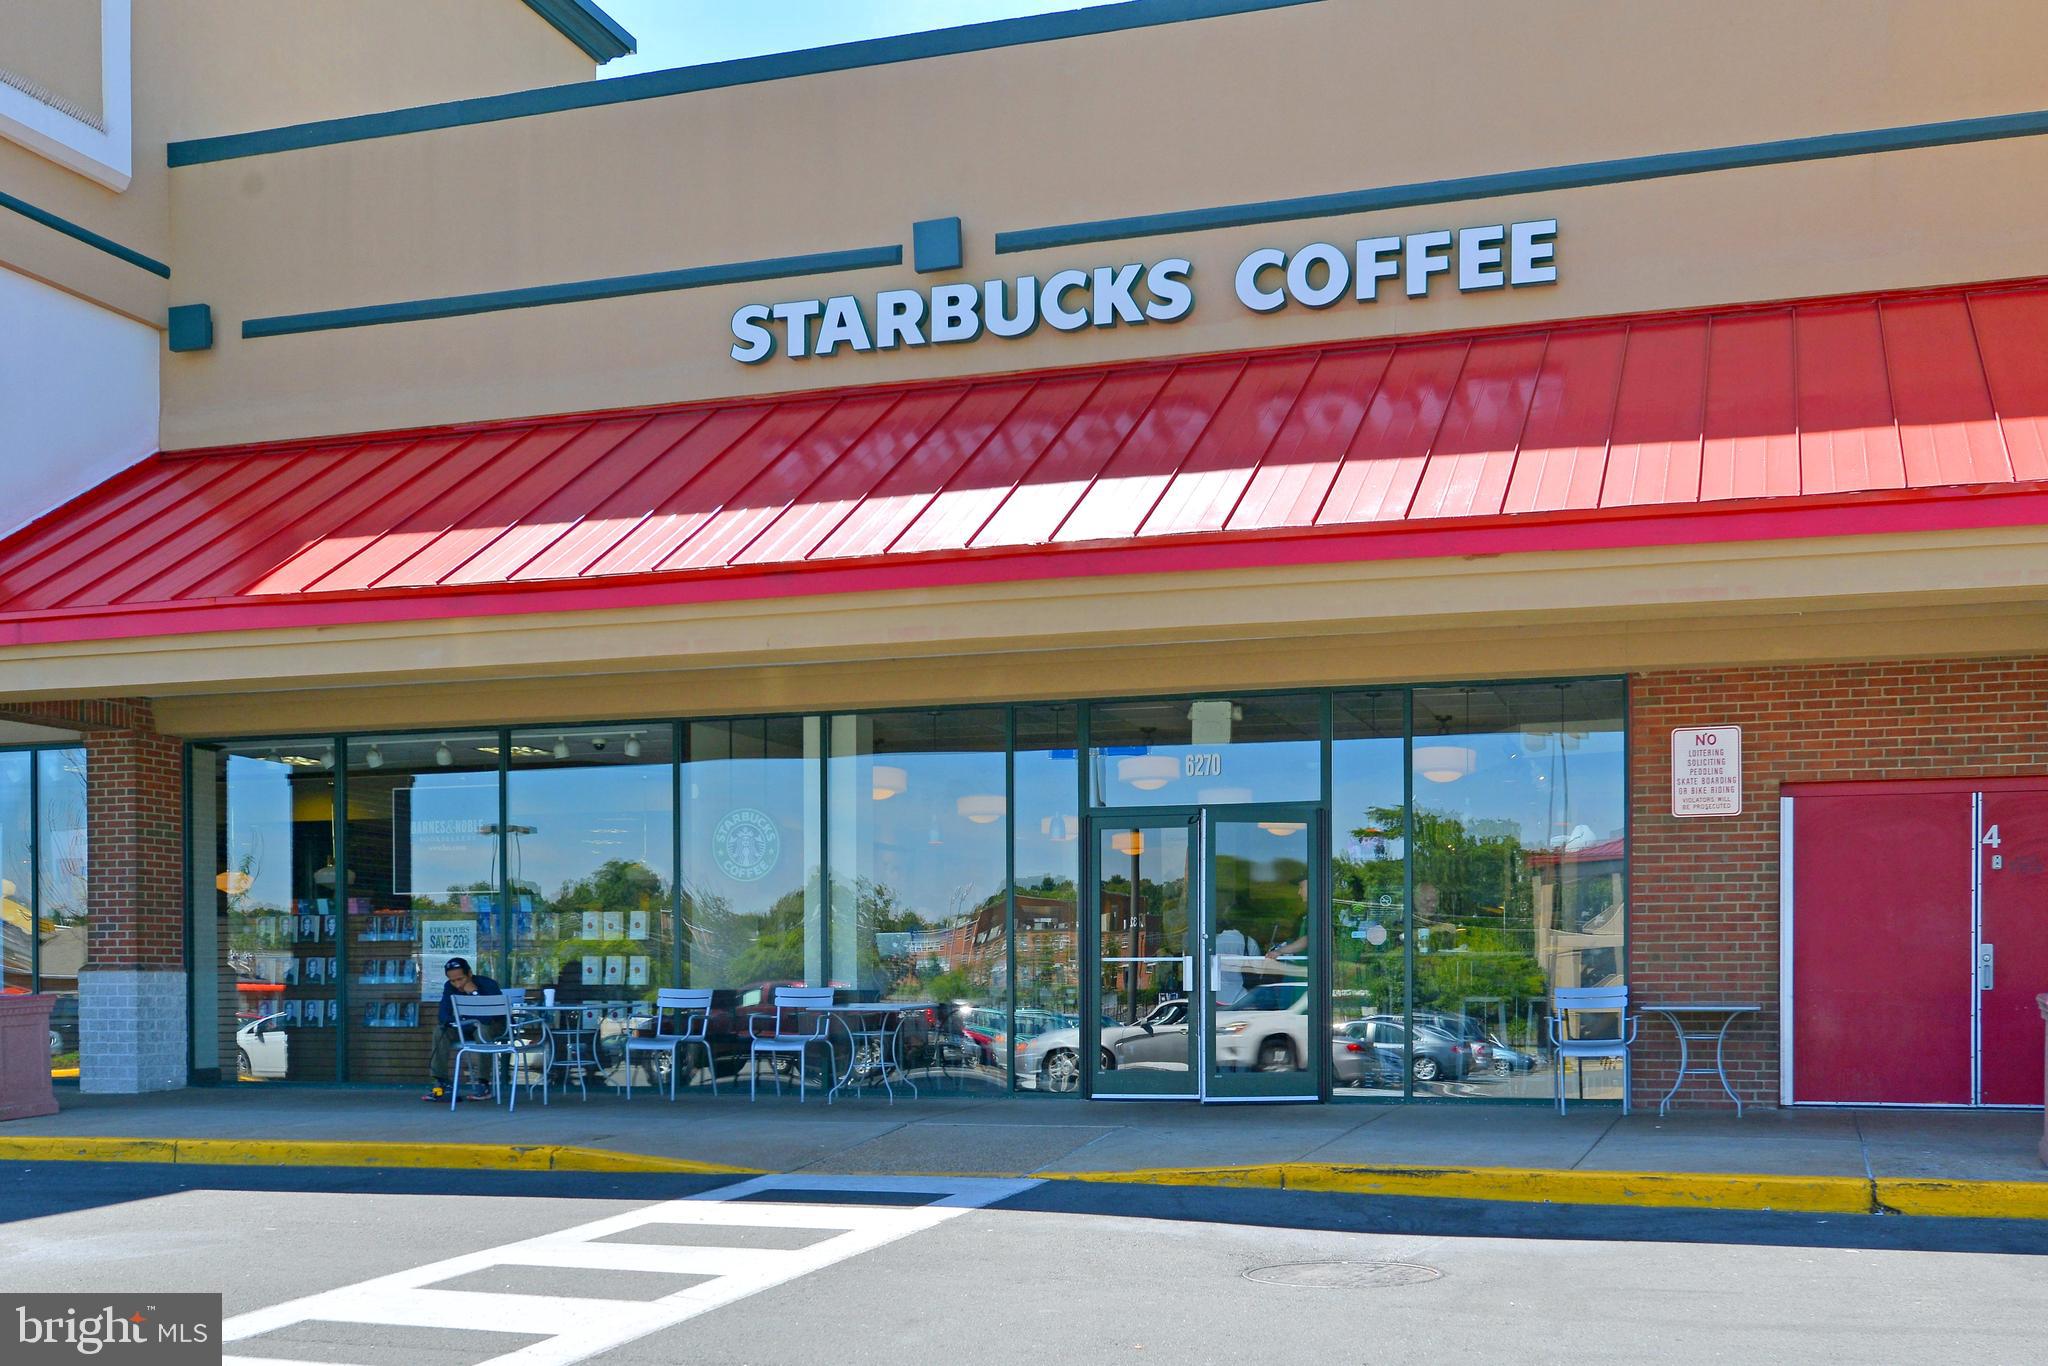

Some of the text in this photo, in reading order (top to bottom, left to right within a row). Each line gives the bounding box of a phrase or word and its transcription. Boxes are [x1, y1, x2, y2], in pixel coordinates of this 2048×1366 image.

[730, 218, 1559, 366] STARBUCKS COFFEE
[1695, 734, 1717, 746] NO
[1688, 748, 1724, 757] LOITERING
[1185, 753, 1222, 777] 6270
[1687, 758, 1726, 767] SOLICITING
[1689, 767, 1724, 776] PEDDLING
[1677, 776, 1737, 785] SKATE BOARDING
[1678, 785, 1735, 795] OR BIKE RIDING
[715, 811, 776, 842] STARBUCKS
[1982, 824, 2001, 848] 4
[724, 860, 769, 878] COFFEE
[430, 935, 452, 949] SAVE
